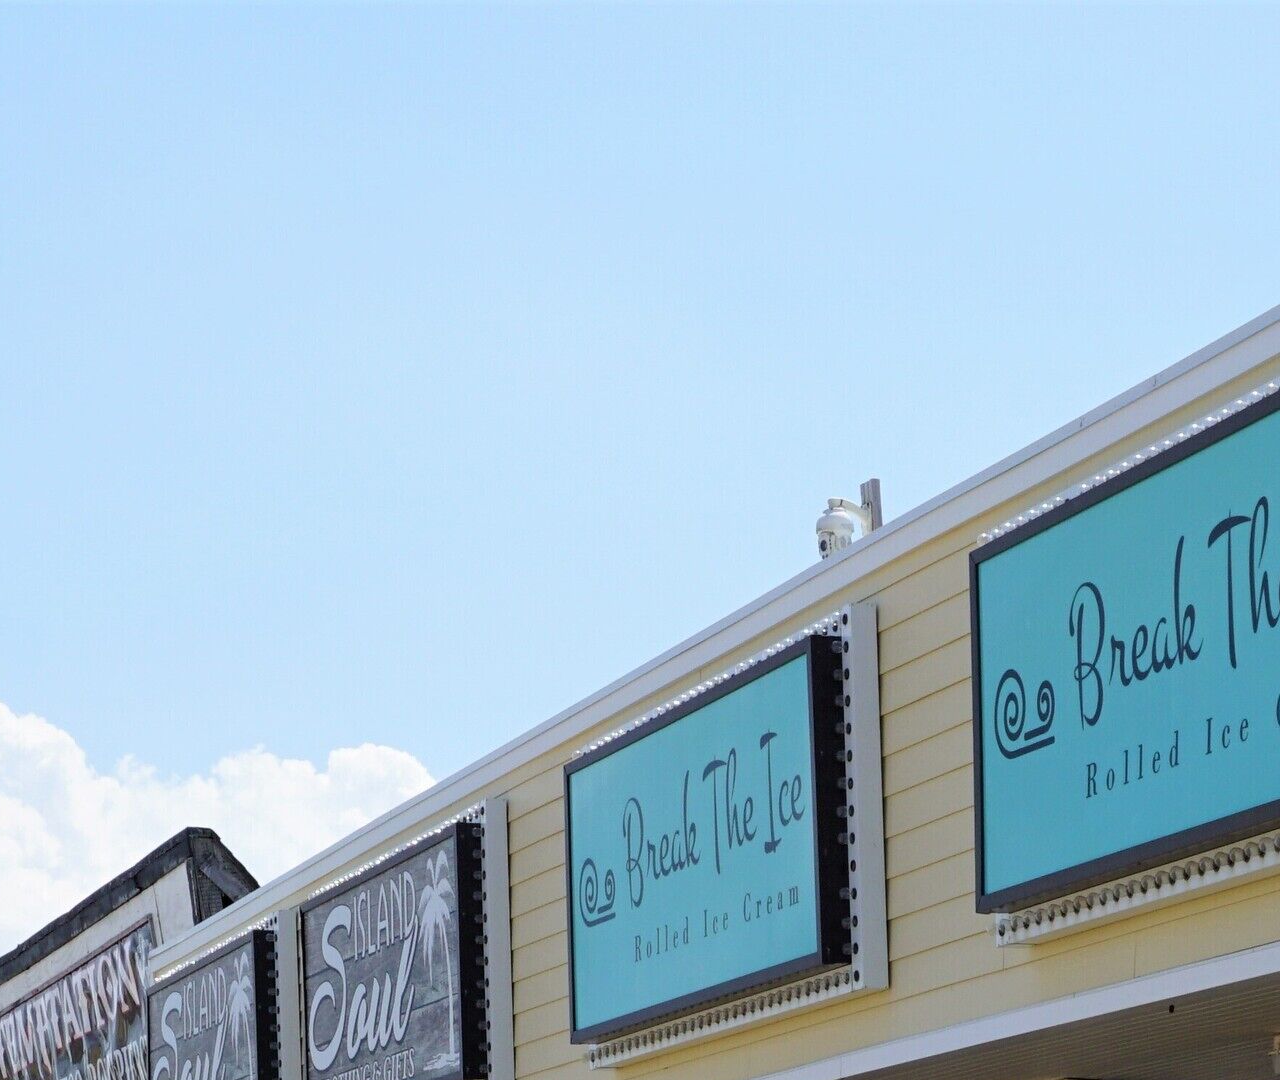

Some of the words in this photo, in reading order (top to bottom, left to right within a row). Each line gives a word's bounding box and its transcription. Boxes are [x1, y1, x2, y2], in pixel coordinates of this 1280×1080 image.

[1068, 535, 1203, 727] Break
[1086, 741, 1180, 799] Rolled
[1205, 716, 1250, 755] Ice
[622, 771, 700, 908] Break
[702, 748, 756, 875] The
[760, 730, 805, 853] Ice
[353, 871, 417, 961] ISLAND
[634, 919, 689, 962] Rolled
[703, 904, 730, 937] Ice
[743, 884, 800, 923] Cream
[182, 966, 228, 1041] ISLAND
[308, 905, 420, 1071] Soul
